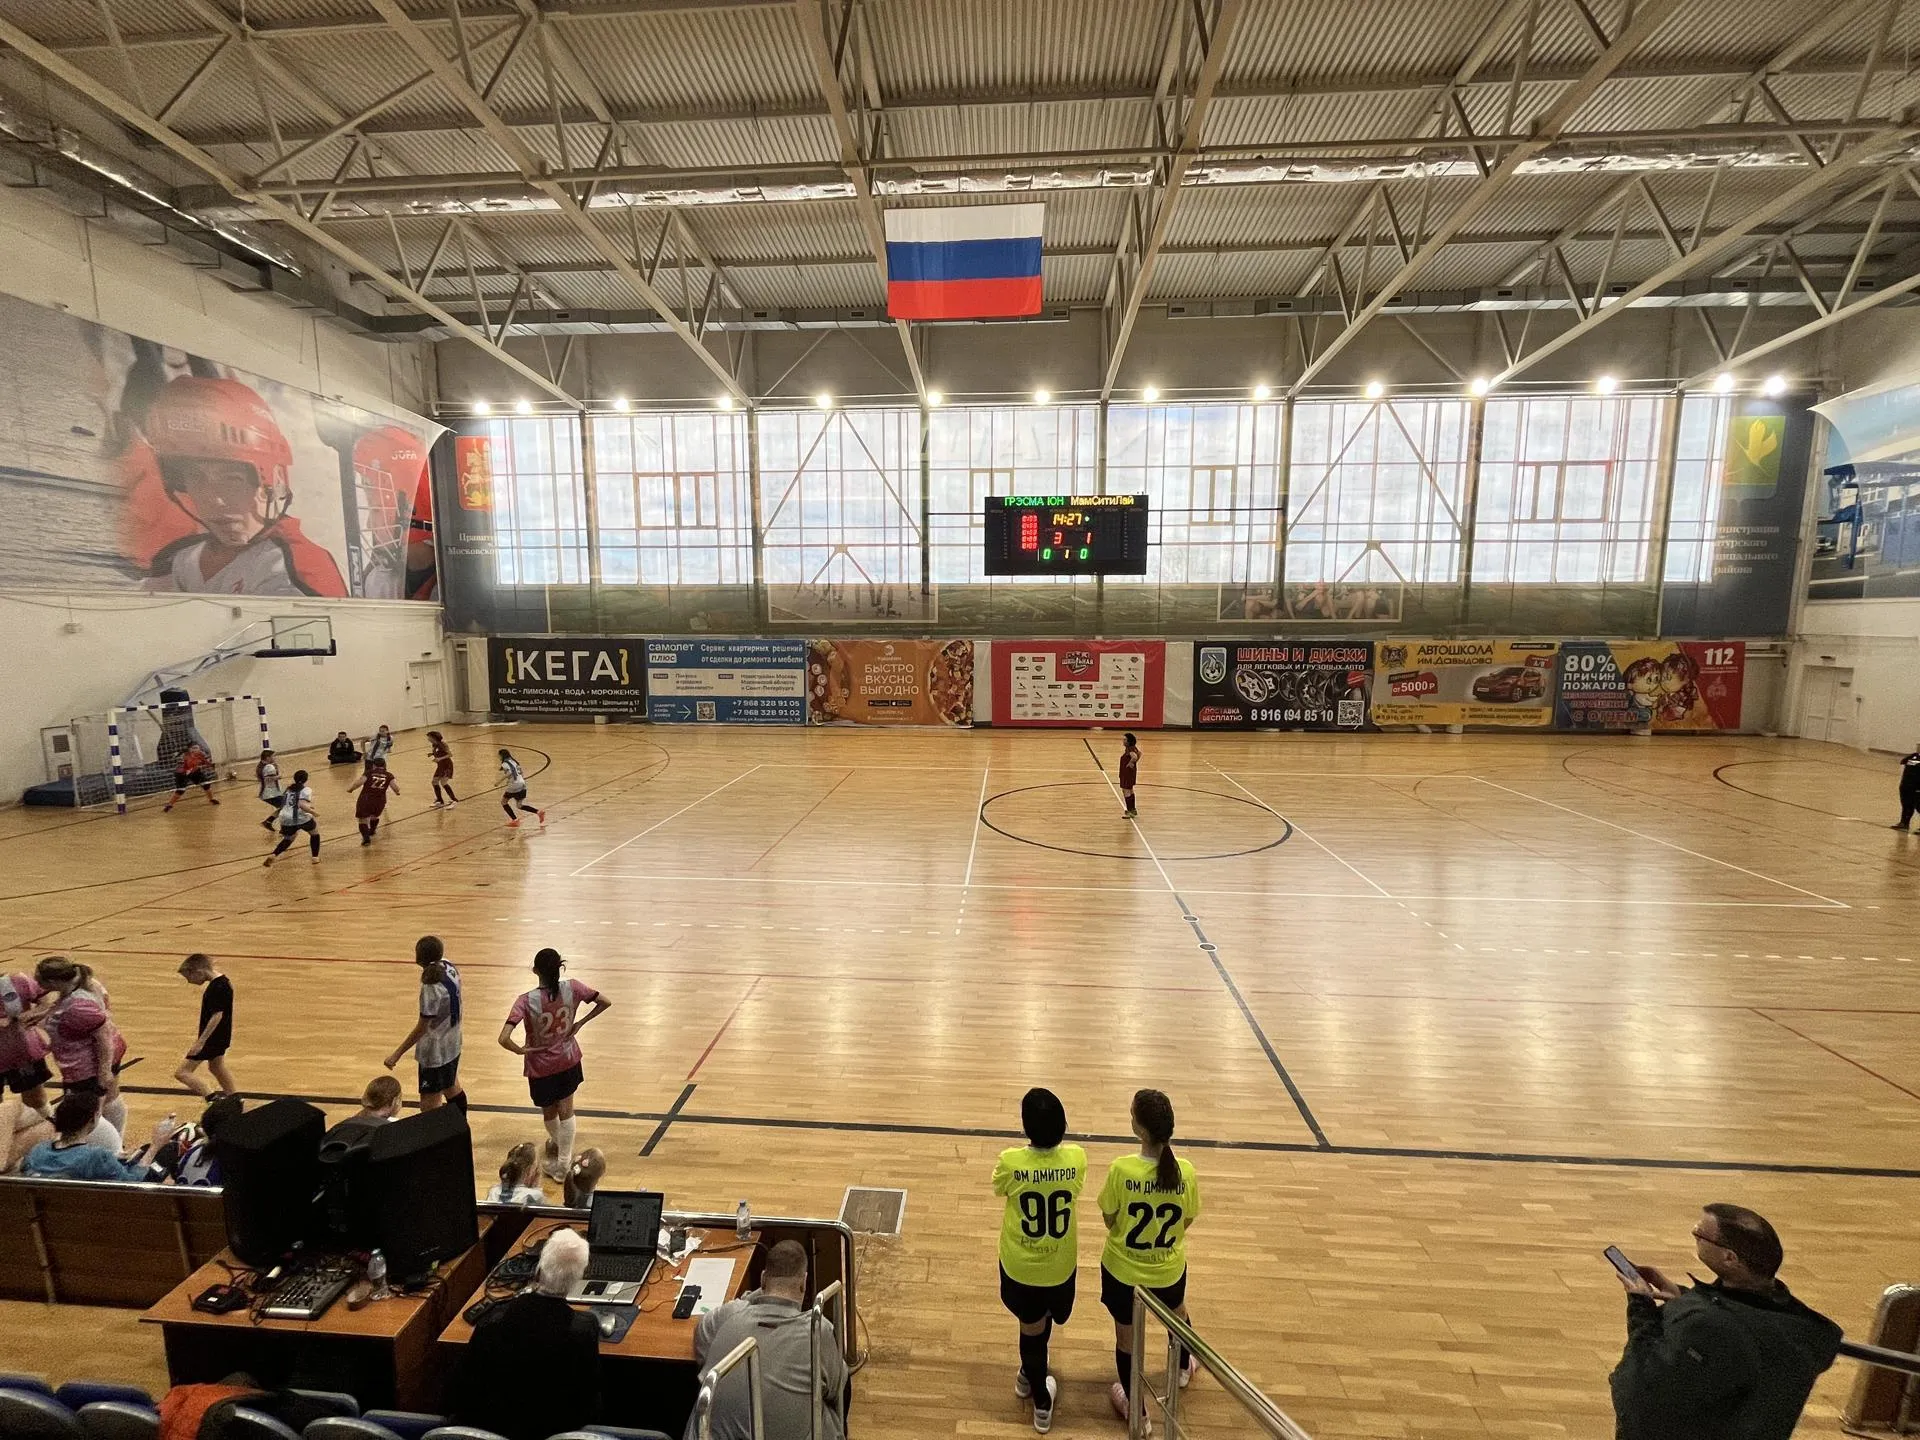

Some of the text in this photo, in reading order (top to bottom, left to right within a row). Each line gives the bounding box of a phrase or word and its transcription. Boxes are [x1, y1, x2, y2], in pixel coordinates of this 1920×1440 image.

[1053, 513, 1082, 526] 14:27
[1053, 532, 1092, 544] 3 1
[1043, 548, 1088, 560] 0 1 0
[648, 643, 694, 651] самолет
[772, 644, 803, 654] решений
[1417, 645, 1493, 656] АВТОШКОЛА
[777, 655, 804, 663] мебели
[1237, 648, 1367, 663] ШИНЫ И ДИСКИ
[1704, 648, 1735, 665] 112
[516, 651, 620, 681] КЕГА
[864, 663, 914, 673] БЫСТРО
[1565, 655, 1616, 672] 80%
[865, 674, 914, 684] ВКУСНО
[1563, 673, 1616, 681] ПРИЧИН
[523, 688, 559, 696] ЛИМОНАД
[564, 689, 586, 697] ВОДА
[860, 685, 919, 697] ВЫГОДНО
[1401, 681, 1428, 692] 5000
[1562, 682, 1626, 691] ПОЖАРОВ
[1251, 709, 1258, 721] 8
[1260, 709, 1281, 721] 916
[1304, 709, 1318, 722] 85
[1320, 709, 1334, 721] 10
[538, 1006, 572, 1039] 23
[1014, 1167, 1076, 1184] ФМ ДМИТРОВ
[1126, 1180, 1185, 1195] ФМ ДМОВ
[1019, 1190, 1073, 1239] 96
[1126, 1202, 1182, 1250] 22
